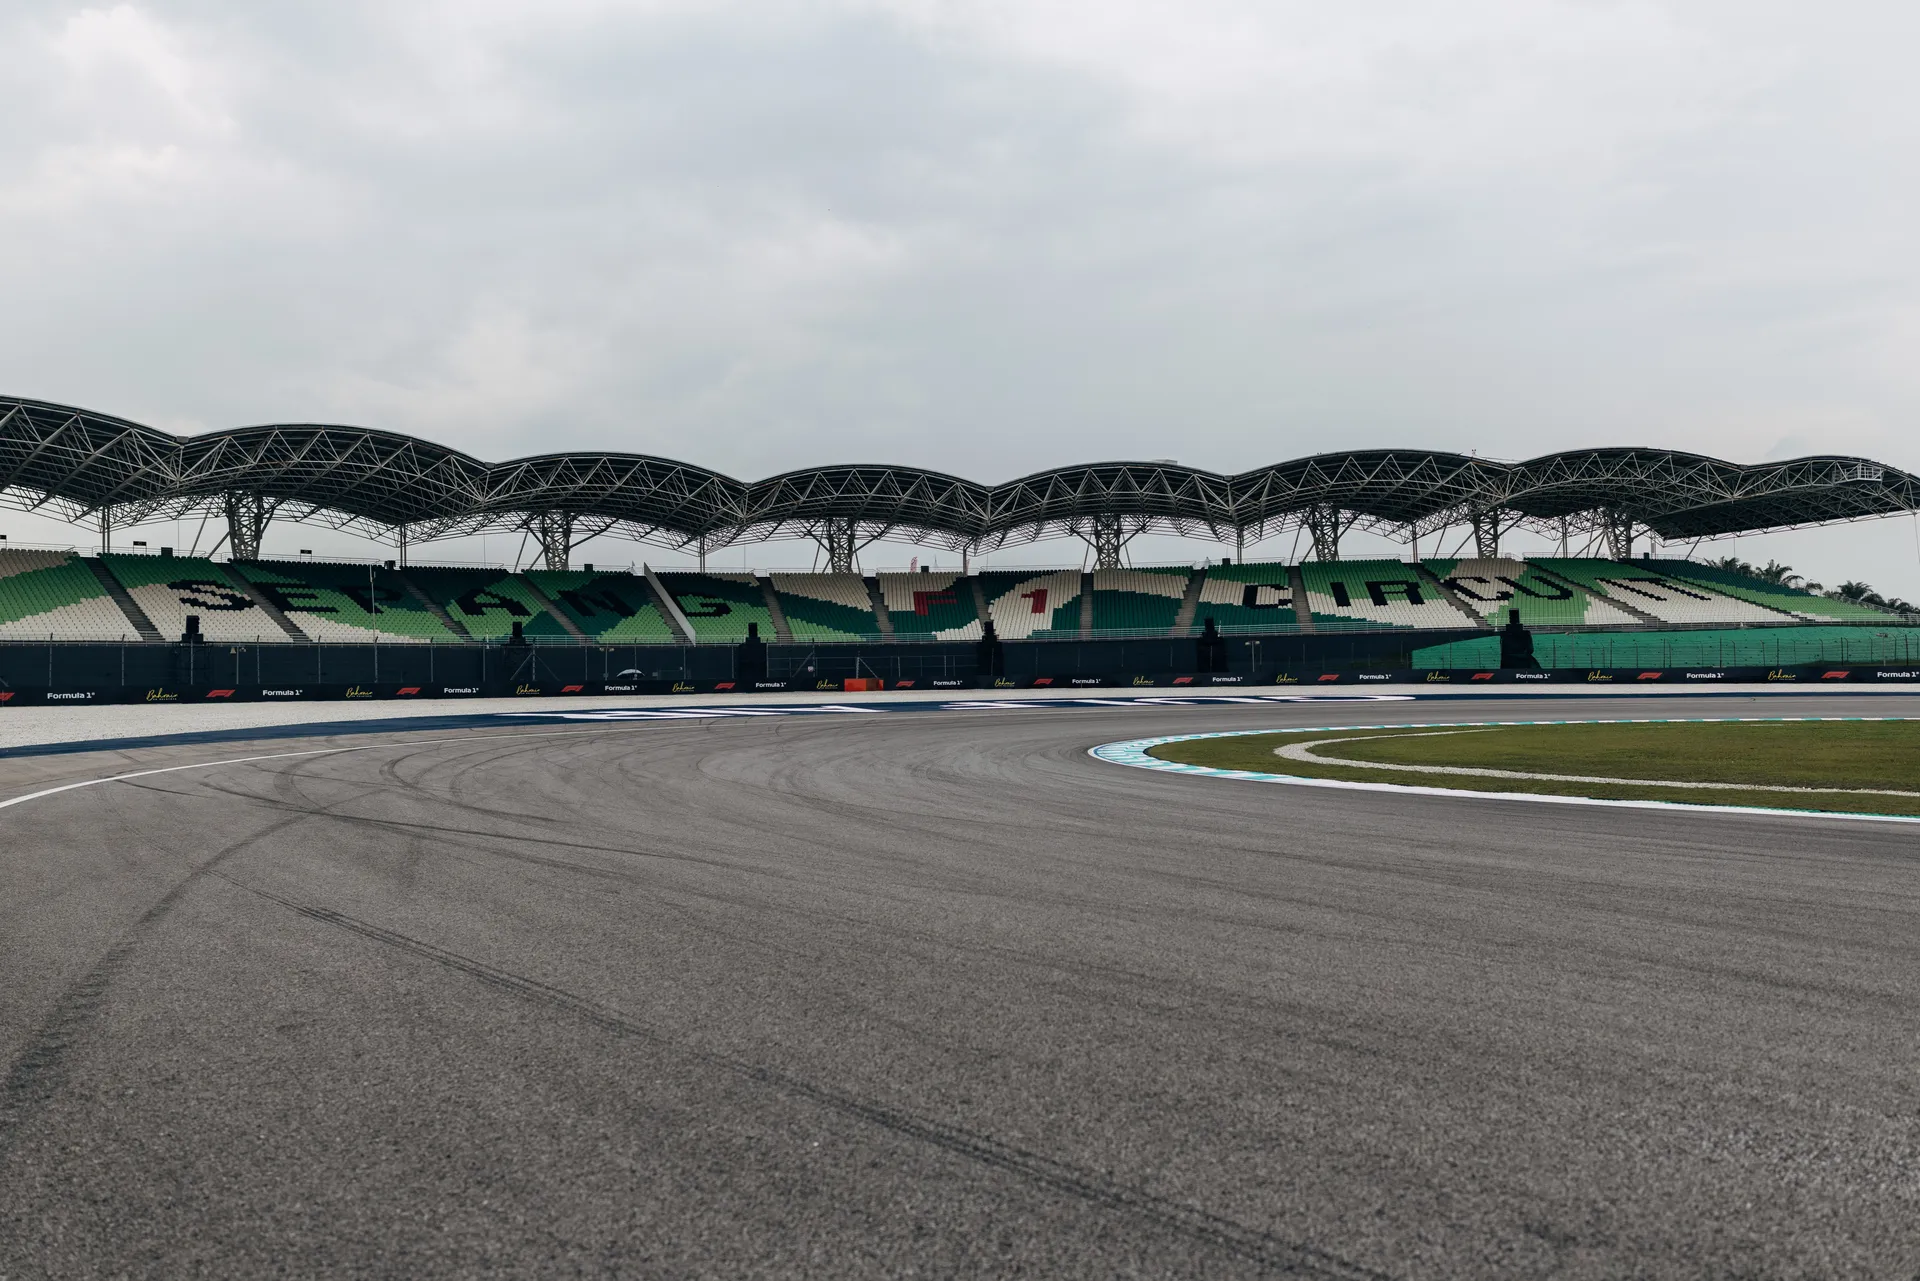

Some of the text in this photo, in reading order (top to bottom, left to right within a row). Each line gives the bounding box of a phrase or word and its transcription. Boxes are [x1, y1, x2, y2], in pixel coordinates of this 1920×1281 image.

[168, 579, 733, 617] SEPANG
[1242, 576, 1712, 610] CIRCUIT
[494, 694, 1418, 720] GULF AIR
